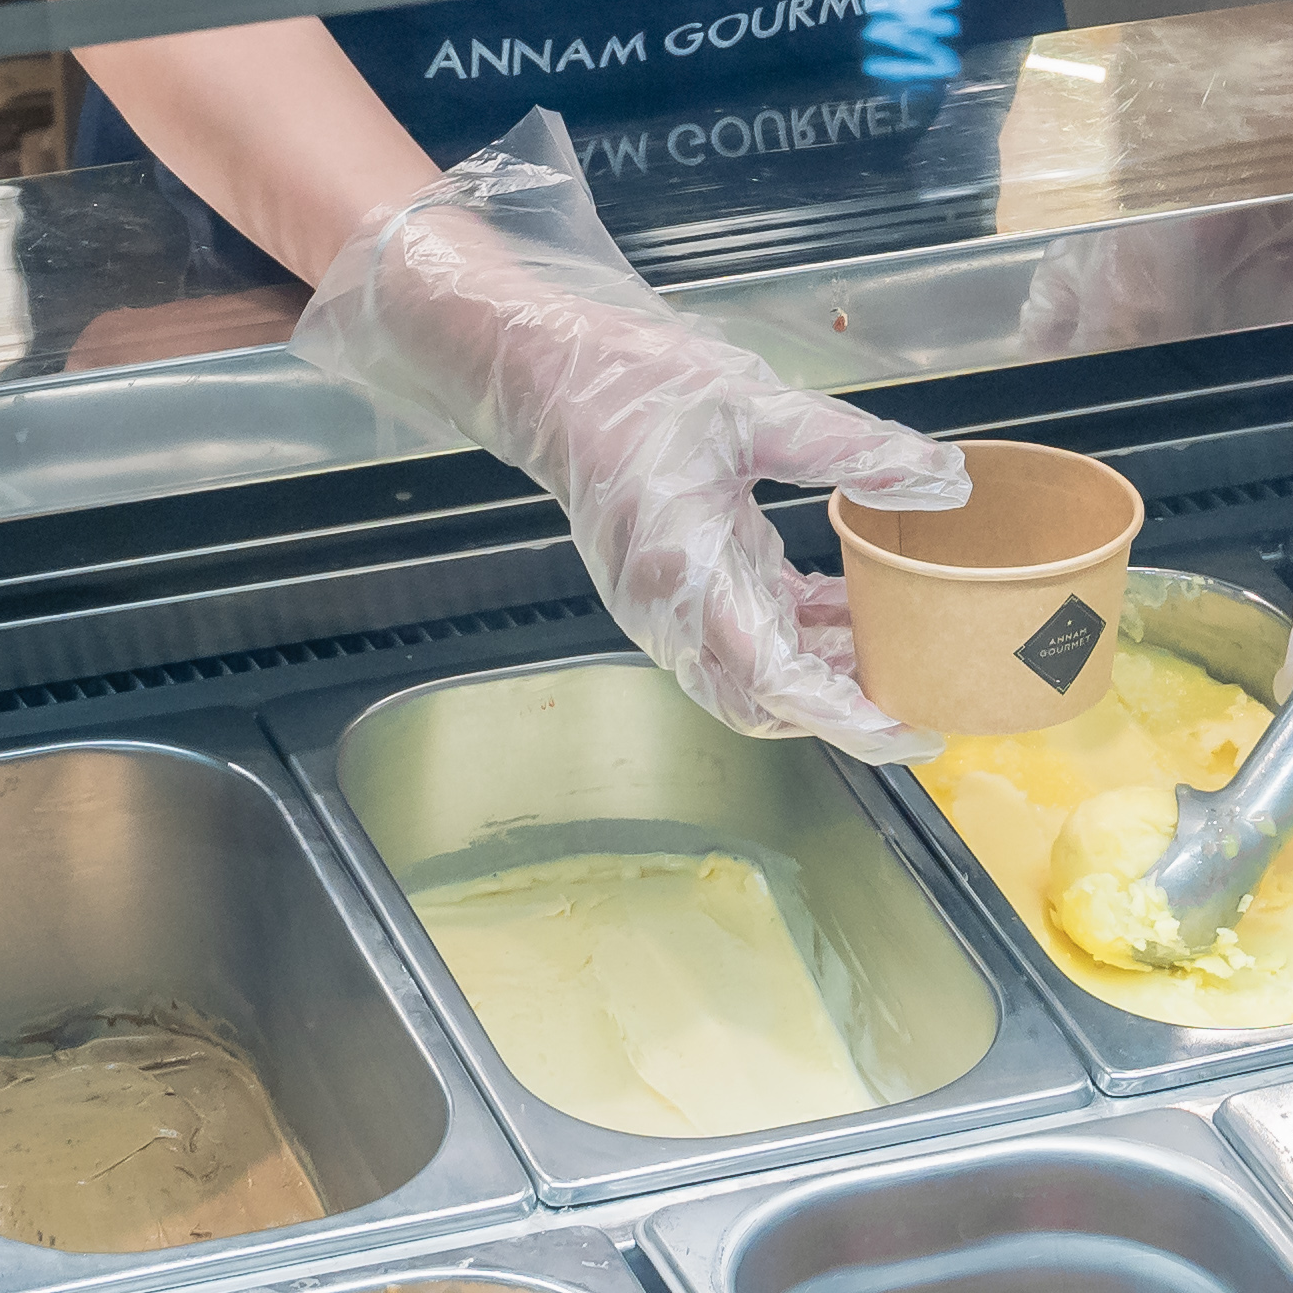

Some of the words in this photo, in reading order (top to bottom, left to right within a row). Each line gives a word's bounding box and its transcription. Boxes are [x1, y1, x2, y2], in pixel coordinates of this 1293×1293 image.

[423, 30, 648, 80] ANNAM
[1040, 634, 1091, 658] GOURMET
[1049, 627, 1087, 646] ANNAM
